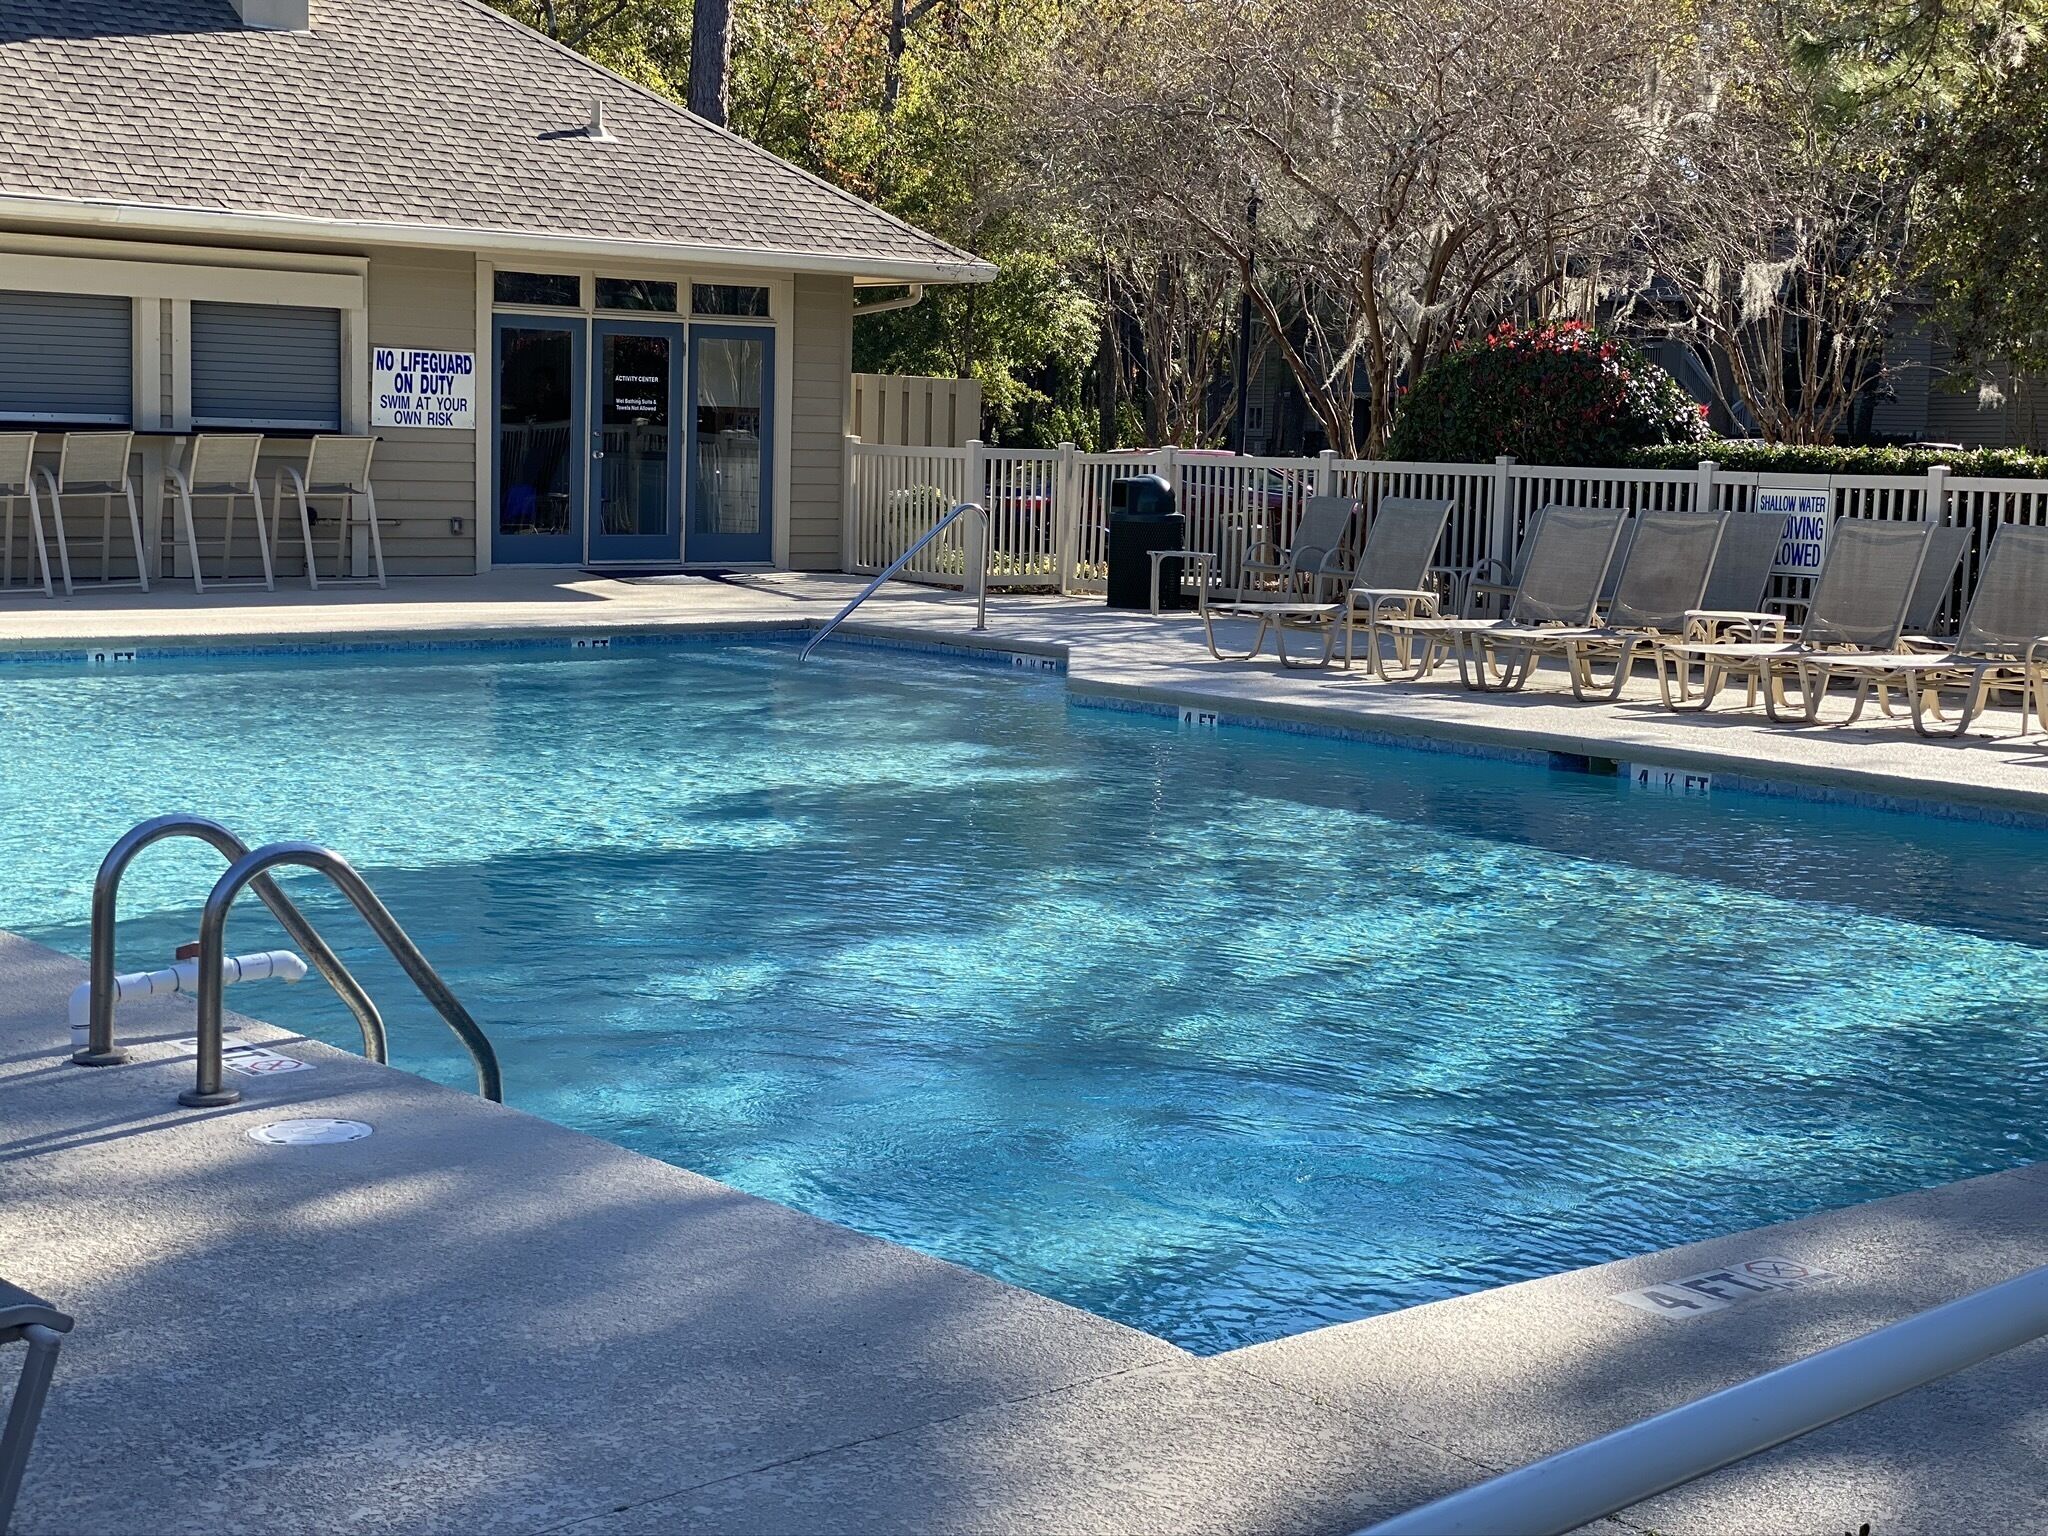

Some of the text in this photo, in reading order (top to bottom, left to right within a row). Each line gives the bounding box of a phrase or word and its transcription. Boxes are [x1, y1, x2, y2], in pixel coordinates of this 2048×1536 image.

[376, 350, 472, 375] NO LIFEGUARD
[394, 373, 454, 395] ON DUTY
[380, 395, 467, 412] SWIM AT YOUR
[394, 410, 453, 426] OWN RISK
[1760, 495, 1826, 513] SHALLOW WATER
[1774, 542, 1820, 567] LOWED
[1643, 1291, 1703, 1310] 4
